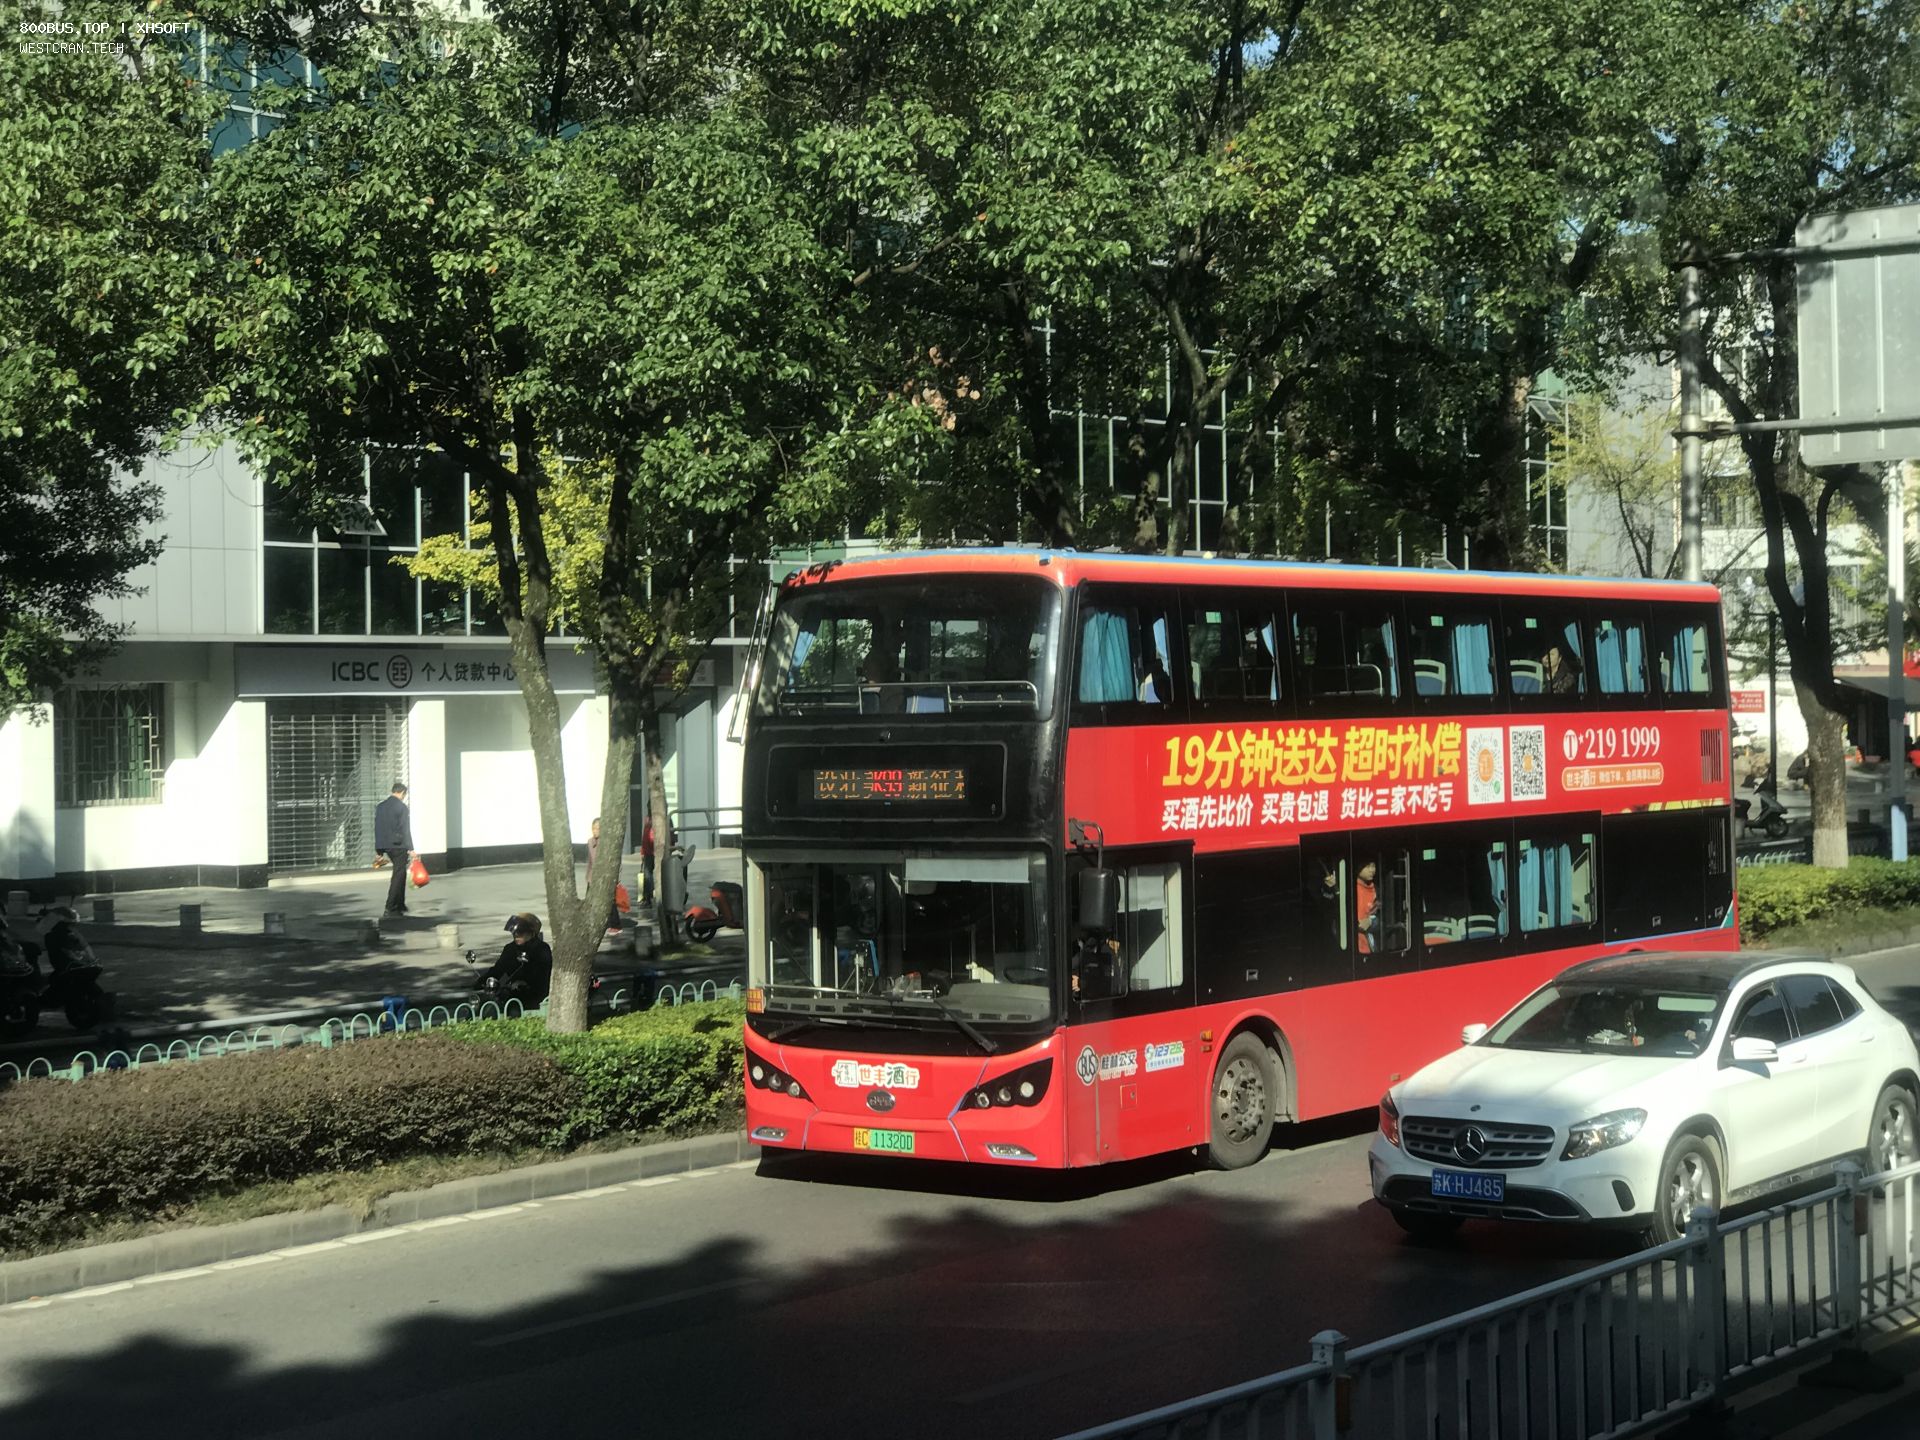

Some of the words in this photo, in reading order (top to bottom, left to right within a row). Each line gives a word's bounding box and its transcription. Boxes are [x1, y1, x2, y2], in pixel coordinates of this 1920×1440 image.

[332, 662, 379, 682] ICBC
[421, 662, 516, 682] 个人贷款中心
[1162, 726, 1339, 790] 19分钟送达
[1341, 721, 1462, 782] 超时补偿
[1585, 727, 1616, 759] 219
[1620, 726, 1661, 758] 1999
[1161, 793, 1254, 831] 买酒先比价
[1261, 789, 1329, 825] 买贵包退
[1340, 782, 1454, 820] 货比三家不吃亏
[860, 1065, 917, 1086] 世丰酒行
[874, 1131, 913, 1150] 11320D
